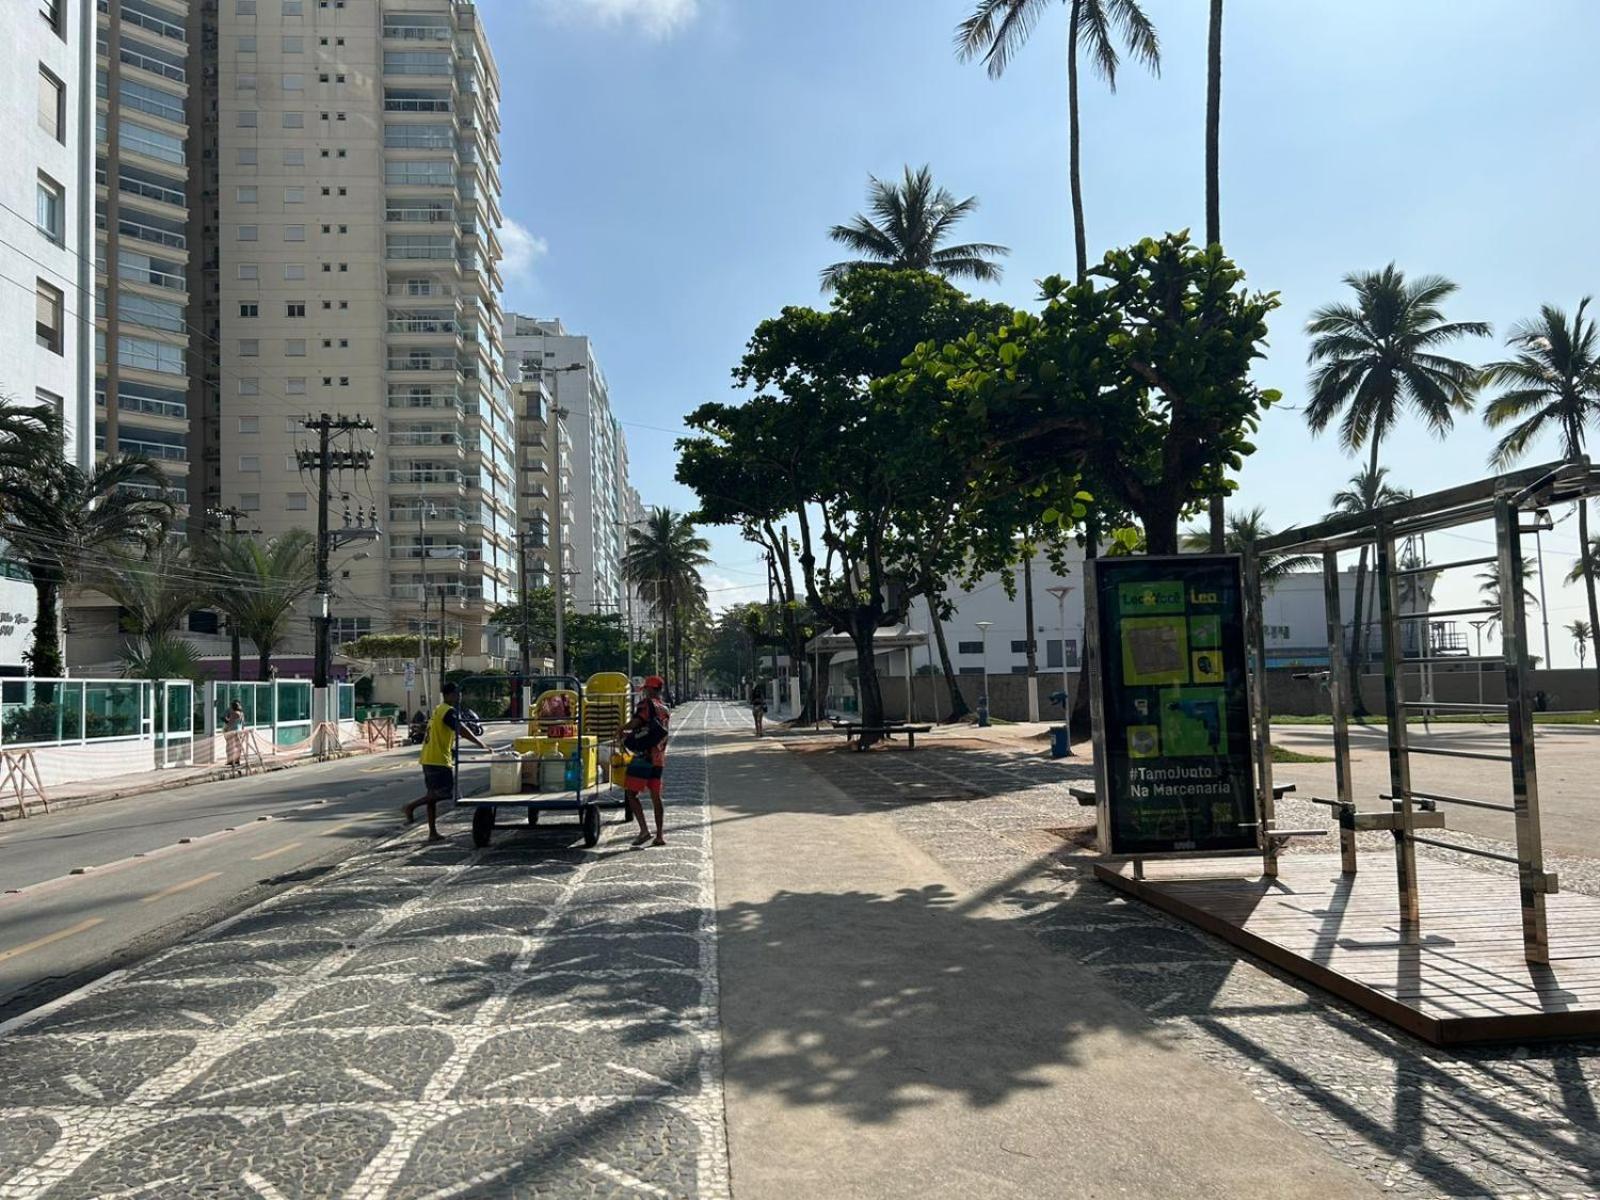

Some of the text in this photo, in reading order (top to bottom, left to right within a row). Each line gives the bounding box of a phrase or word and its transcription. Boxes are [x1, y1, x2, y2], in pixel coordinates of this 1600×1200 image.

[1129, 766, 1212, 780] #TamoJunto
[1131, 782, 1230, 797] Na Marcenaria
